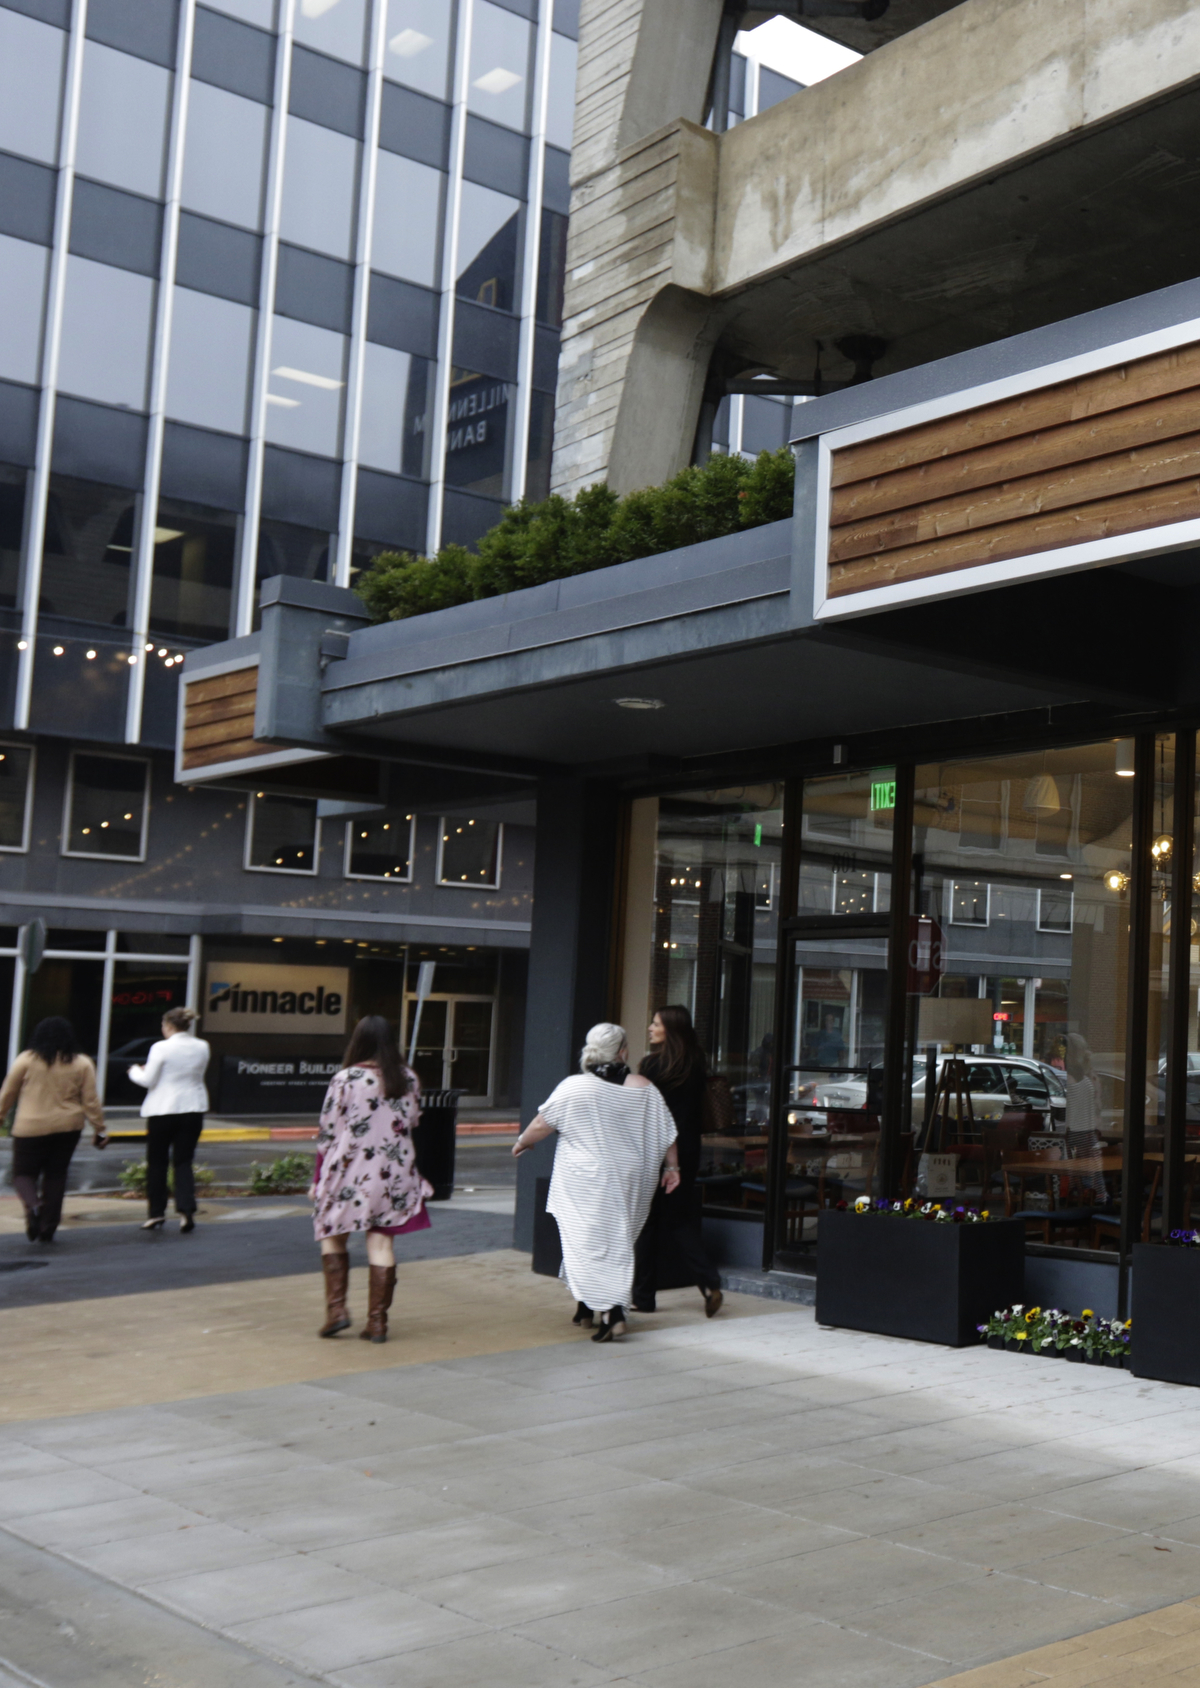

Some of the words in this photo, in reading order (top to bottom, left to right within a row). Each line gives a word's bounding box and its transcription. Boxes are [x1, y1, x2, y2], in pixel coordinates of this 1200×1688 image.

[209, 982, 342, 1016] Pinnacle
[238, 1061, 295, 1075] PIONEER
[299, 1060, 344, 1075] BUILDI
